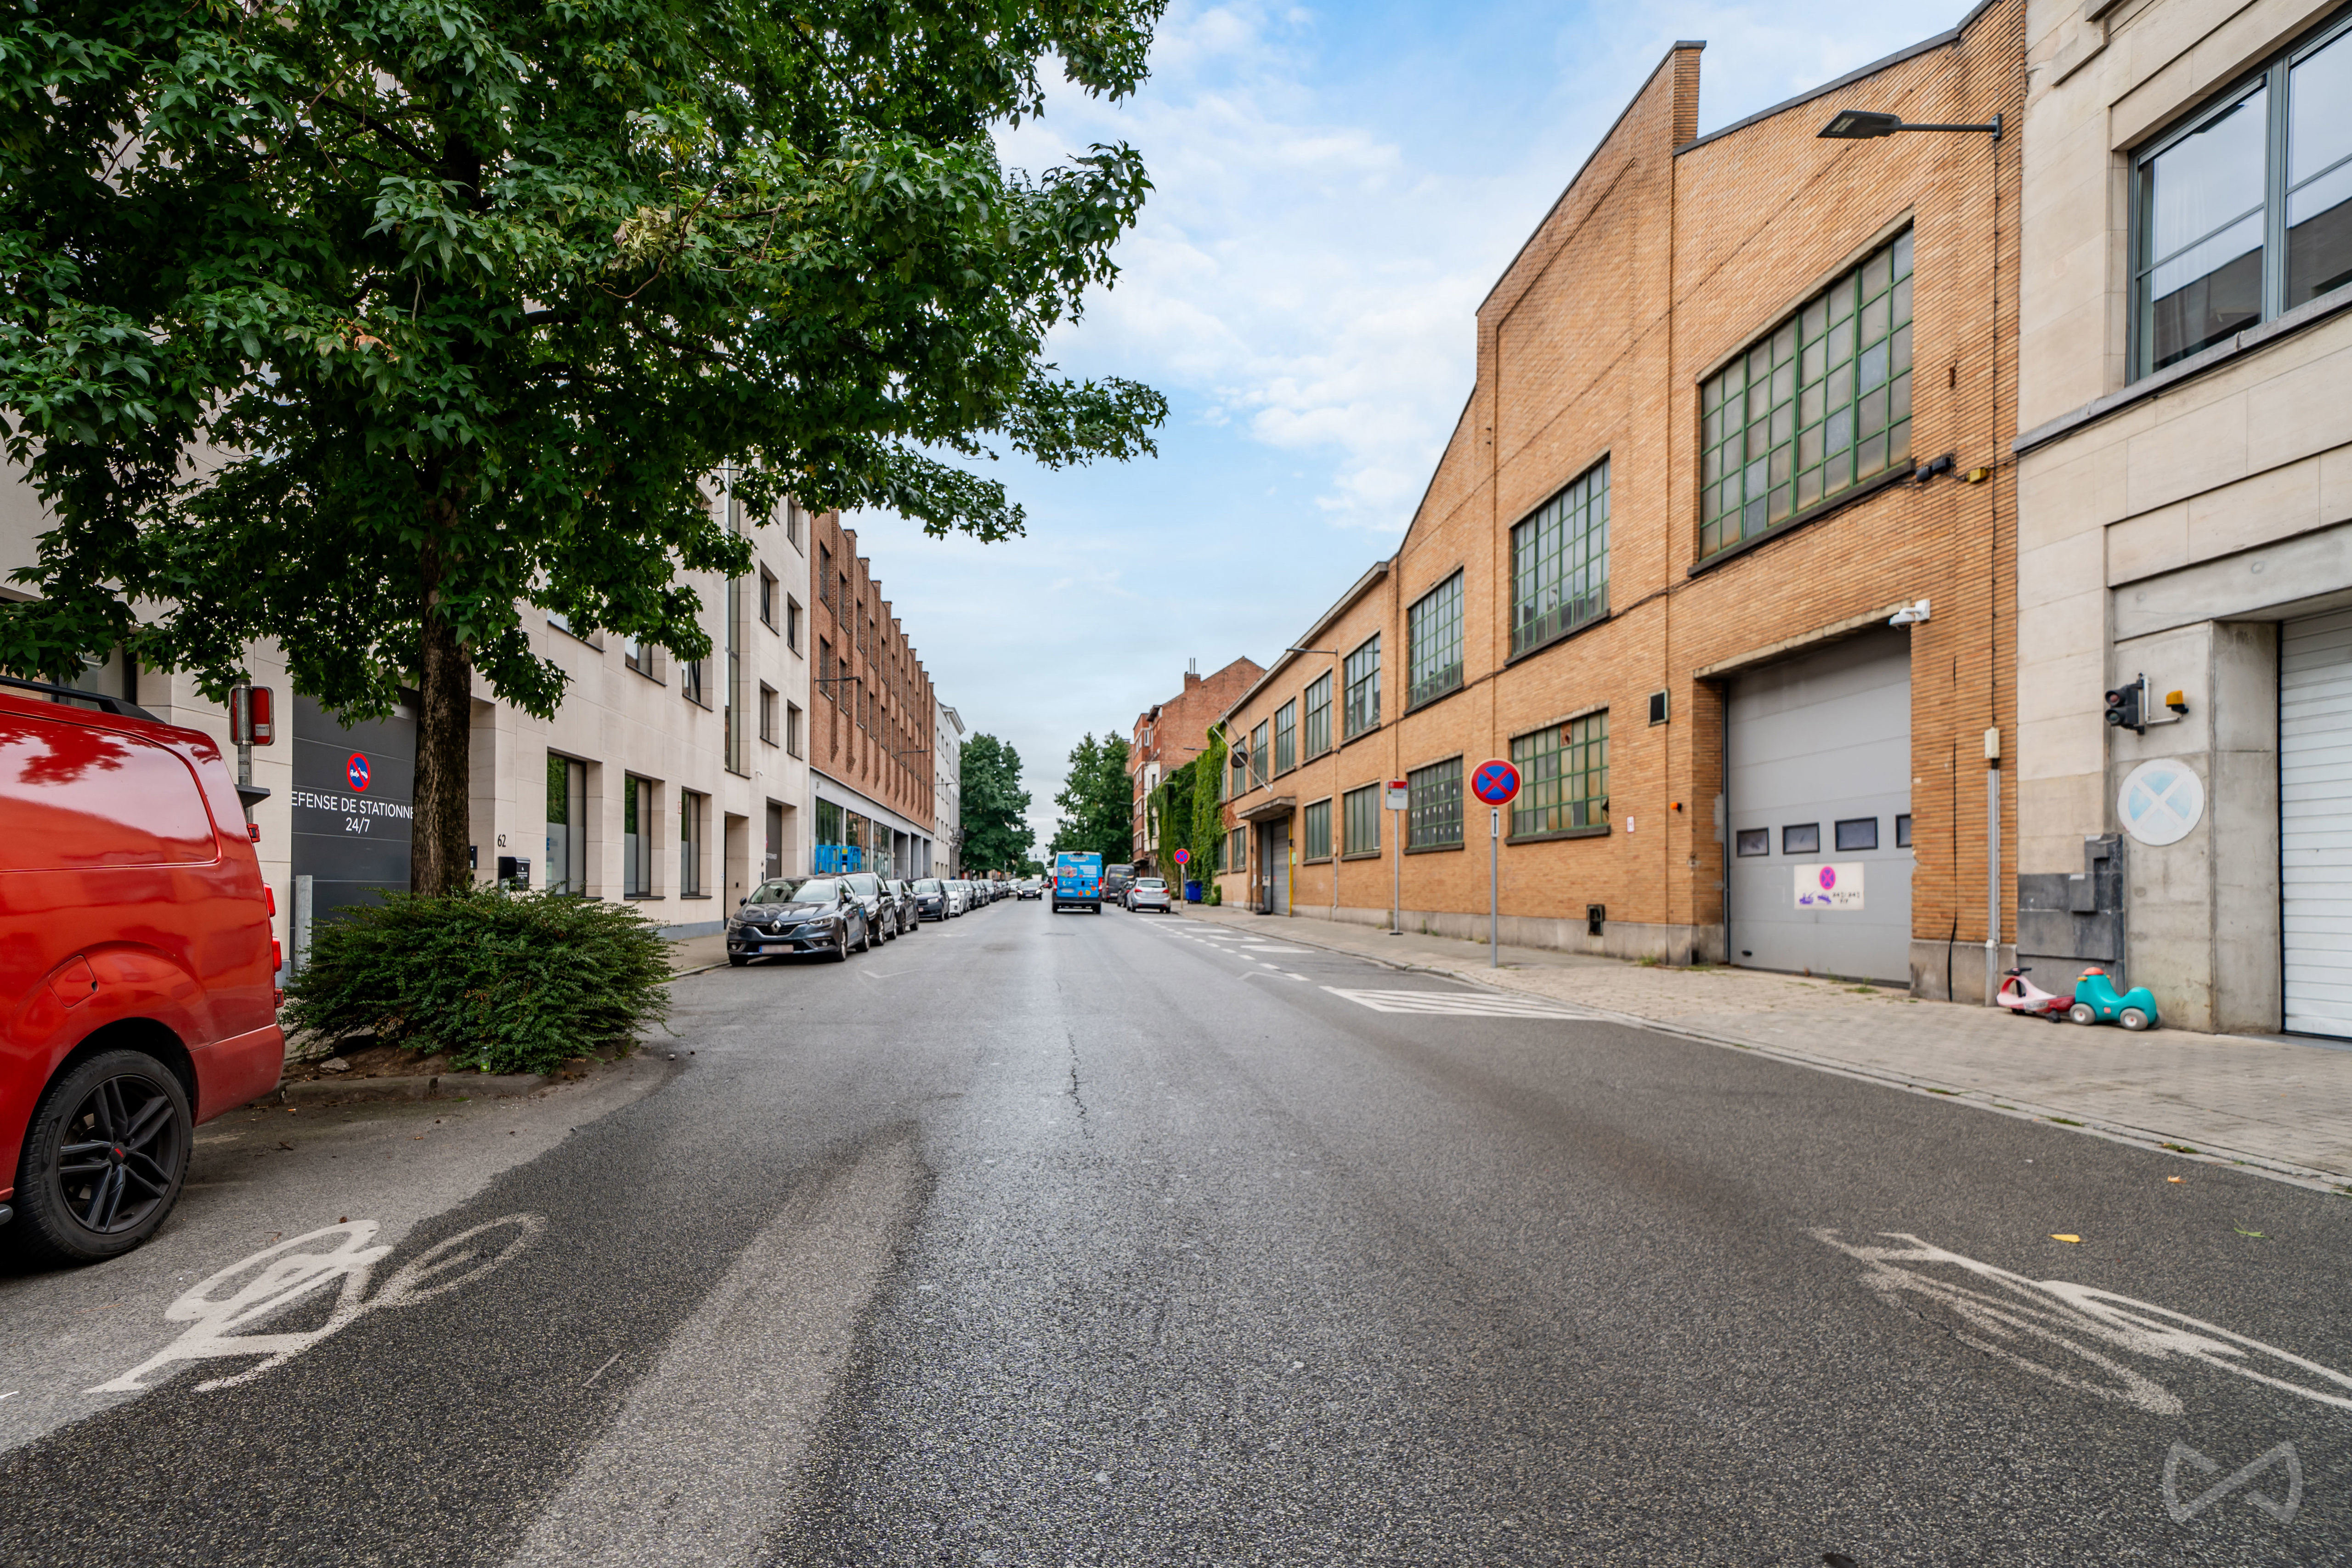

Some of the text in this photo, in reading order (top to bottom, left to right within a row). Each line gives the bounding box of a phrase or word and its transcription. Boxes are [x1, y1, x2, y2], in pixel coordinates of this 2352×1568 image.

[292, 791, 413, 819] EFENSE DE STATIONNE
[345, 817, 370, 834] 24/7
[498, 834, 506, 847] 62
